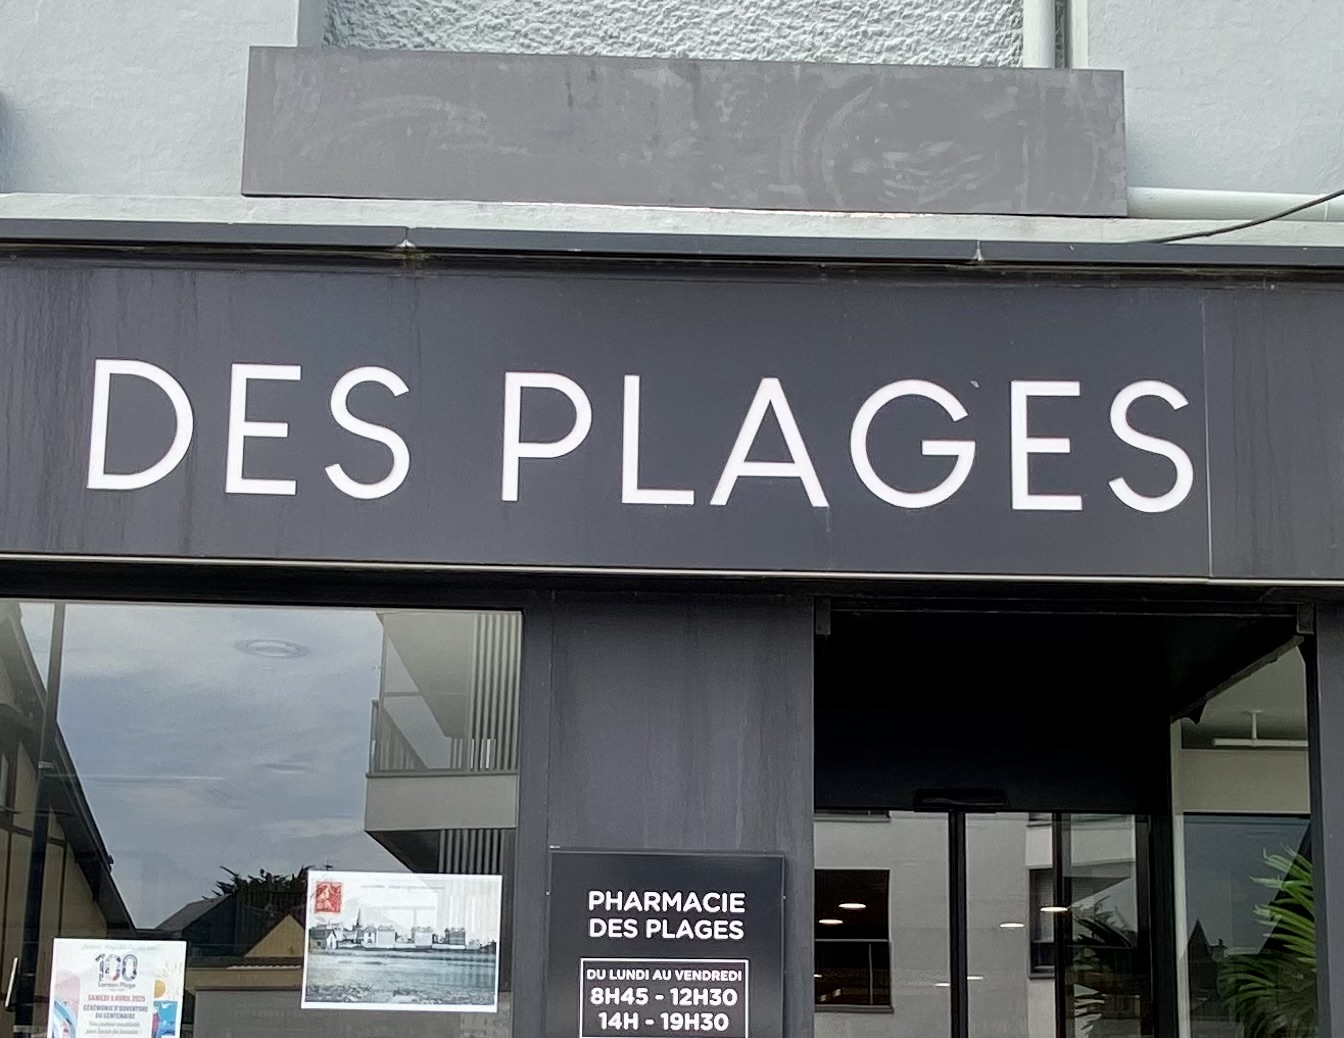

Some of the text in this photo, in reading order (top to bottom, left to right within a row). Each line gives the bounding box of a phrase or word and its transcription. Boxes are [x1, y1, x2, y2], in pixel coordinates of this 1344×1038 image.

[86, 358, 411, 500] DES
[502, 371, 1195, 515] PLAGES
[587, 889, 747, 914] PHARMACIE
[588, 917, 745, 940] DES PLAGES
[95, 953, 138, 982] 100
[586, 968, 743, 982] DU LUNDI AU VENDREDI
[590, 987, 649, 1006] 8H45
[669, 987, 738, 1006] 12H30
[598, 1011, 639, 1031] 14H
[660, 1012, 729, 1031] 19H30
